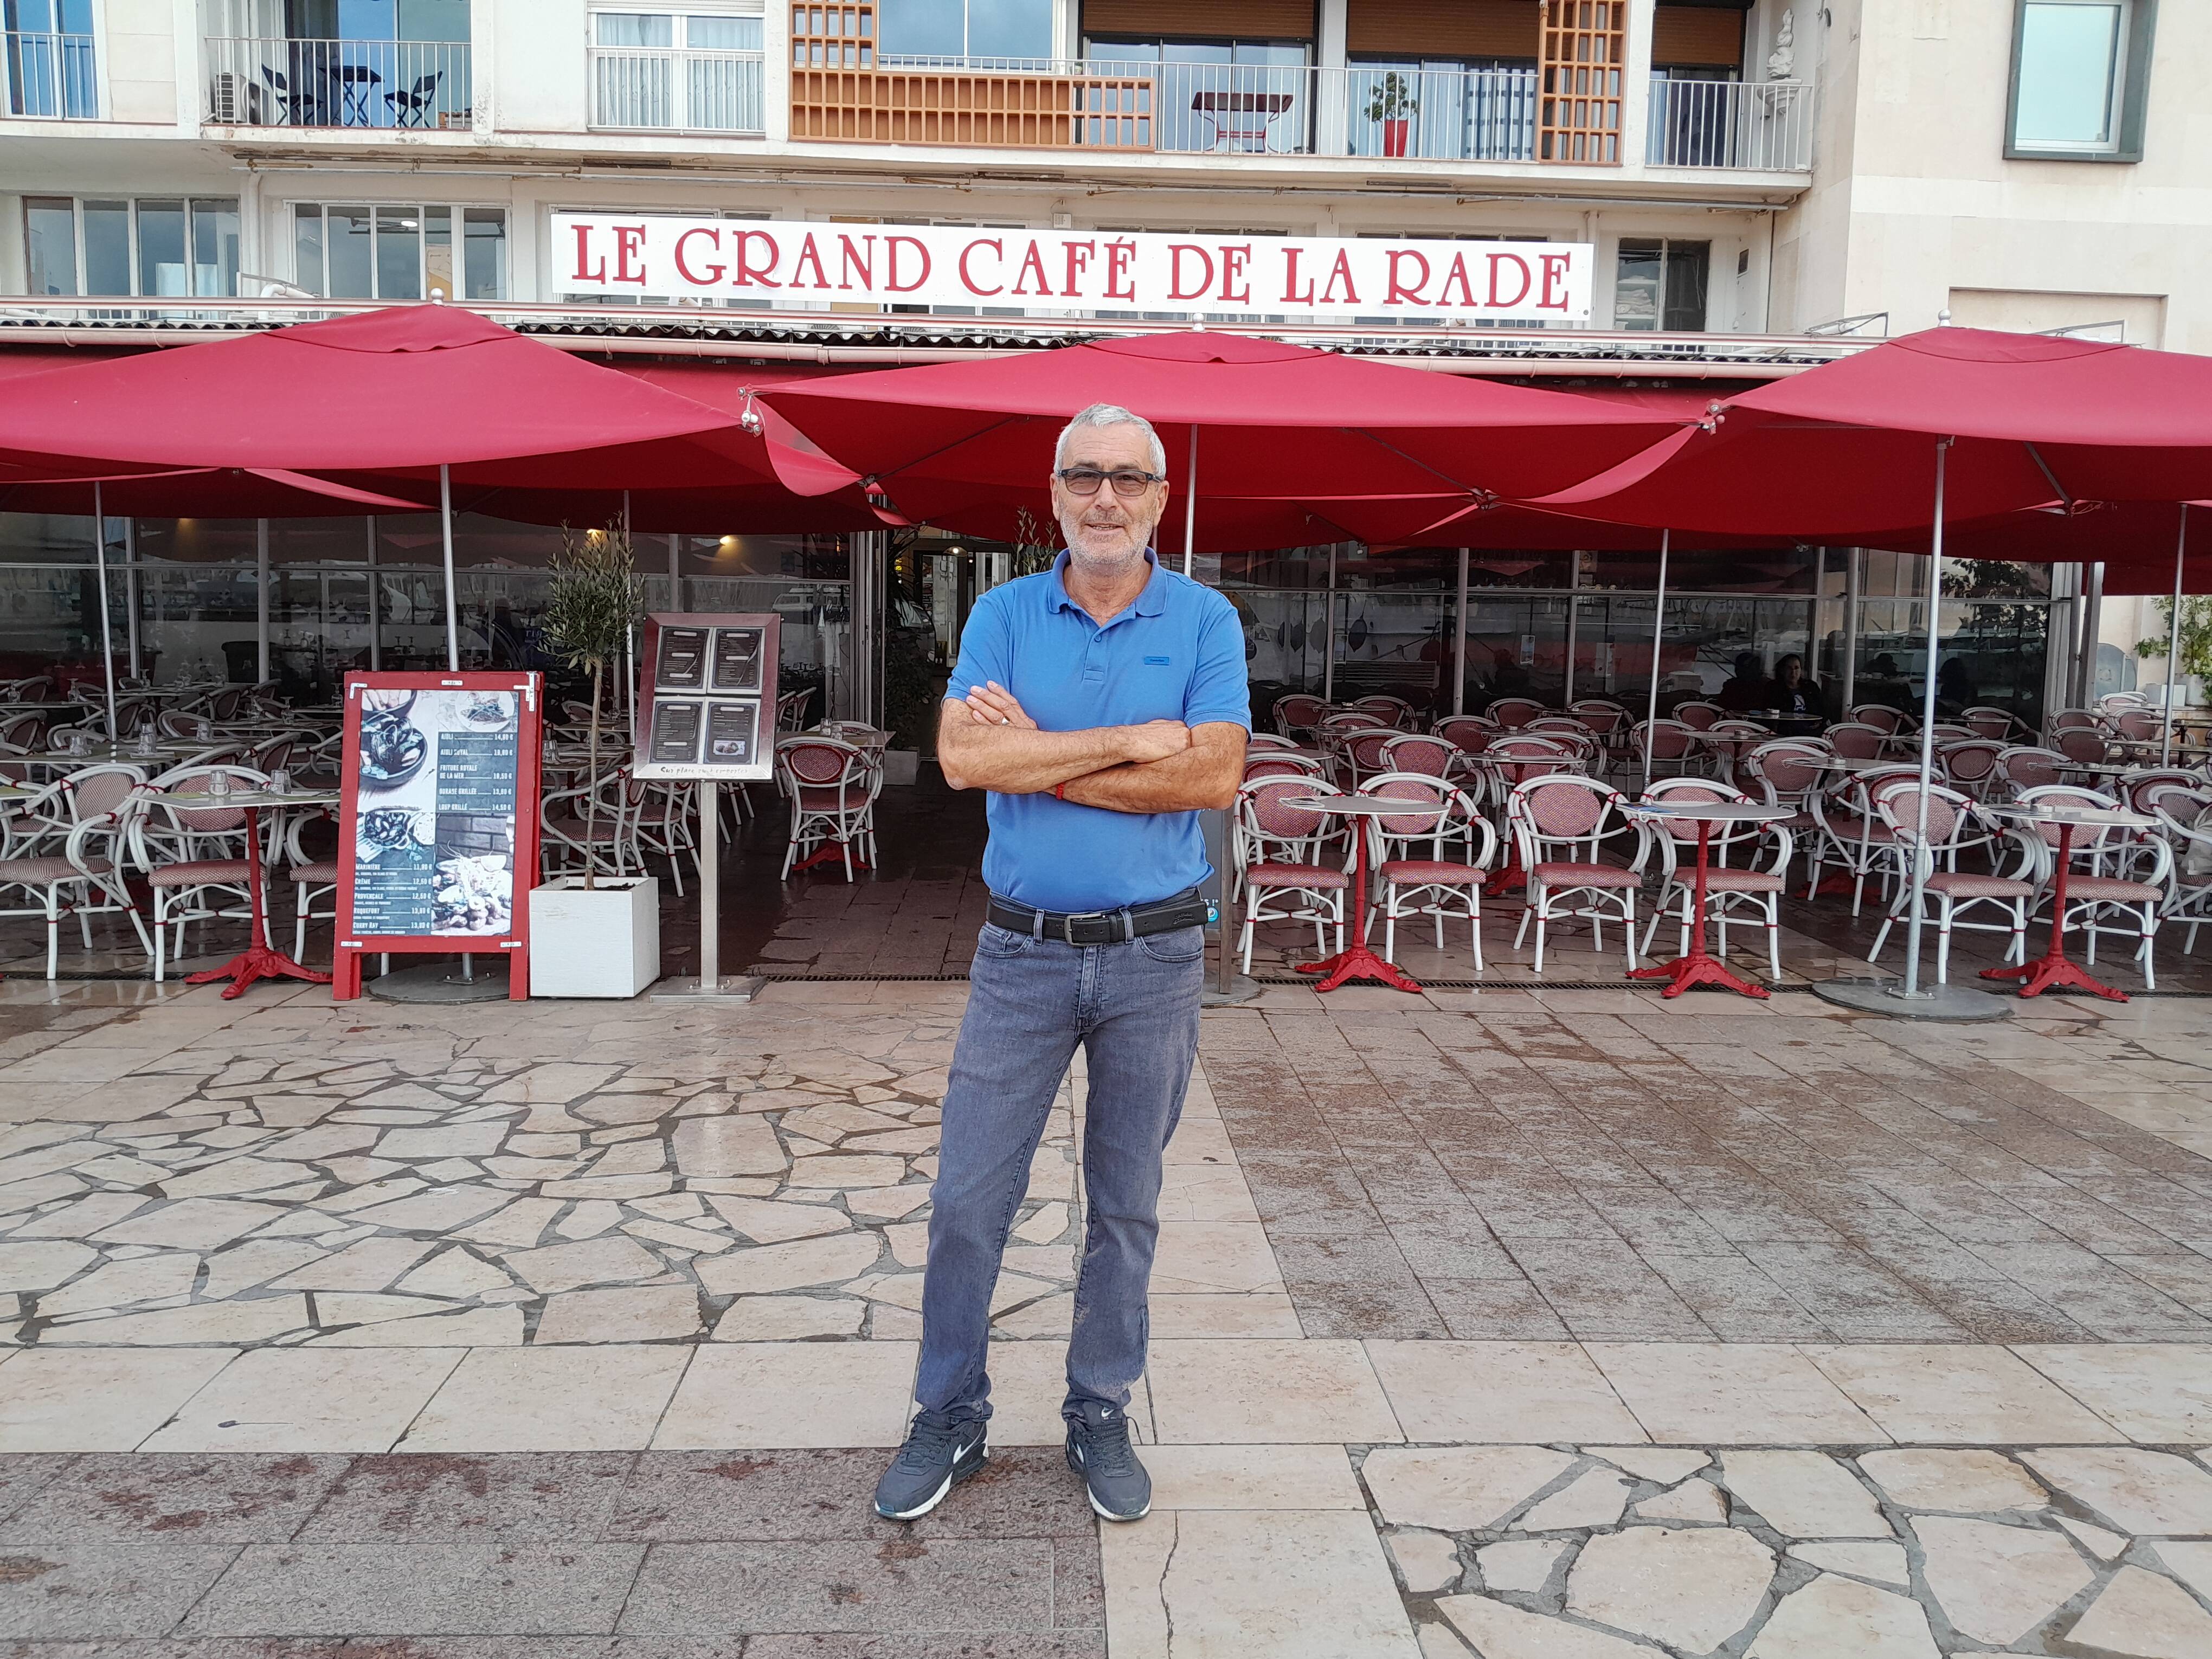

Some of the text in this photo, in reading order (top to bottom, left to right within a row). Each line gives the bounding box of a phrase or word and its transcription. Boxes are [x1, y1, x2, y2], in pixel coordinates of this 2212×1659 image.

[571, 224, 1571, 312] LE GRAND CAFÉ DE LA RADE
